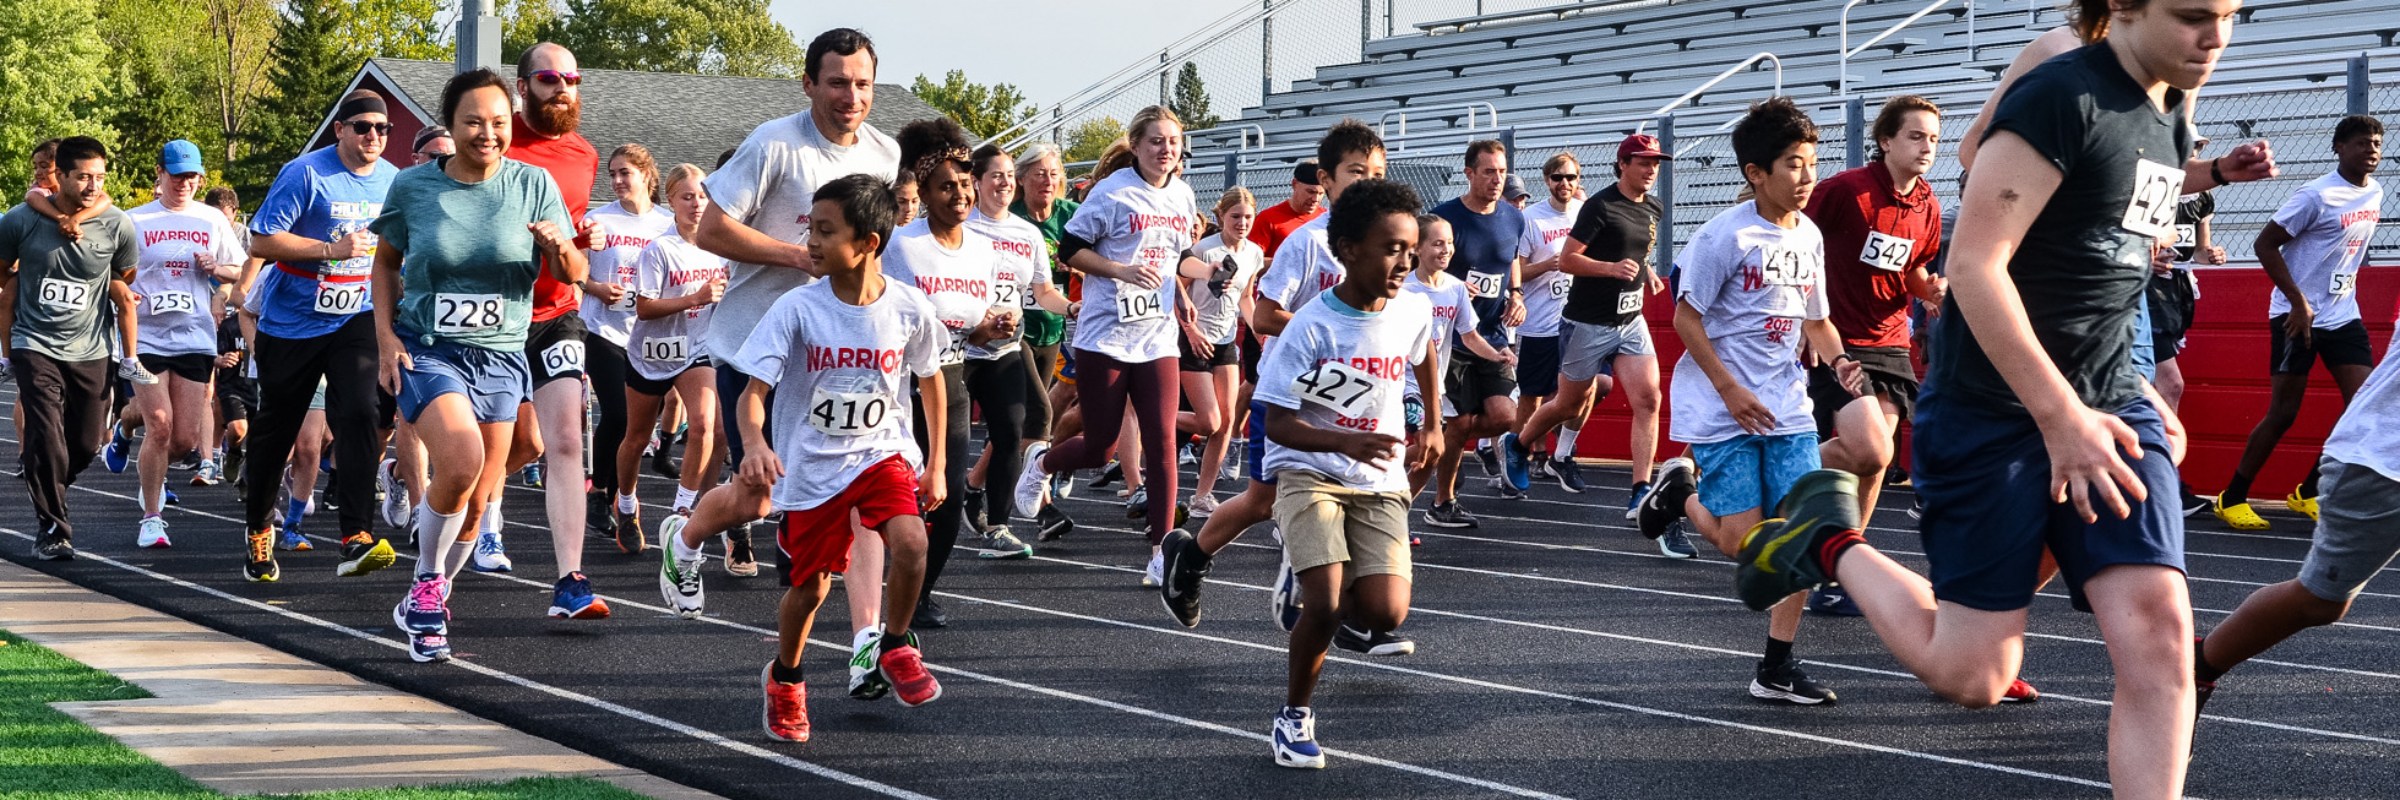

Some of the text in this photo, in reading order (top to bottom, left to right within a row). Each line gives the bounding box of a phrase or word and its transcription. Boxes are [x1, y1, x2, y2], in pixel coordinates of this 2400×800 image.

[1129, 213, 1187, 234] WARRIOR
[2341, 210, 2380, 229] WARRIO
[144, 230, 209, 250] WARRIOR
[1542, 228, 1571, 244] WARR
[2175, 227, 2193, 244] 52
[992, 241, 1033, 261] RRIOR
[1863, 237, 1908, 267] 542
[165, 260, 190, 269] 2023
[170, 269, 183, 277] 5K
[617, 266, 637, 276] 202
[1766, 249, 1810, 279] 40
[669, 267, 725, 288] WARRIO
[1552, 279, 1570, 296] 63
[42, 282, 85, 305] 612
[319, 287, 365, 310] 607
[915, 275, 987, 303] WARRIOR
[994, 284, 1014, 303] 52
[152, 293, 191, 311] 255
[1120, 292, 1160, 319] 104
[438, 298, 501, 328] 228
[1764, 316, 1793, 331] 2023
[1767, 331, 1785, 343] 5K
[546, 343, 584, 369] 60
[644, 341, 686, 360] 101
[1296, 368, 1374, 409] 427
[813, 398, 886, 430] 410
[1335, 412, 1379, 431] 2023
